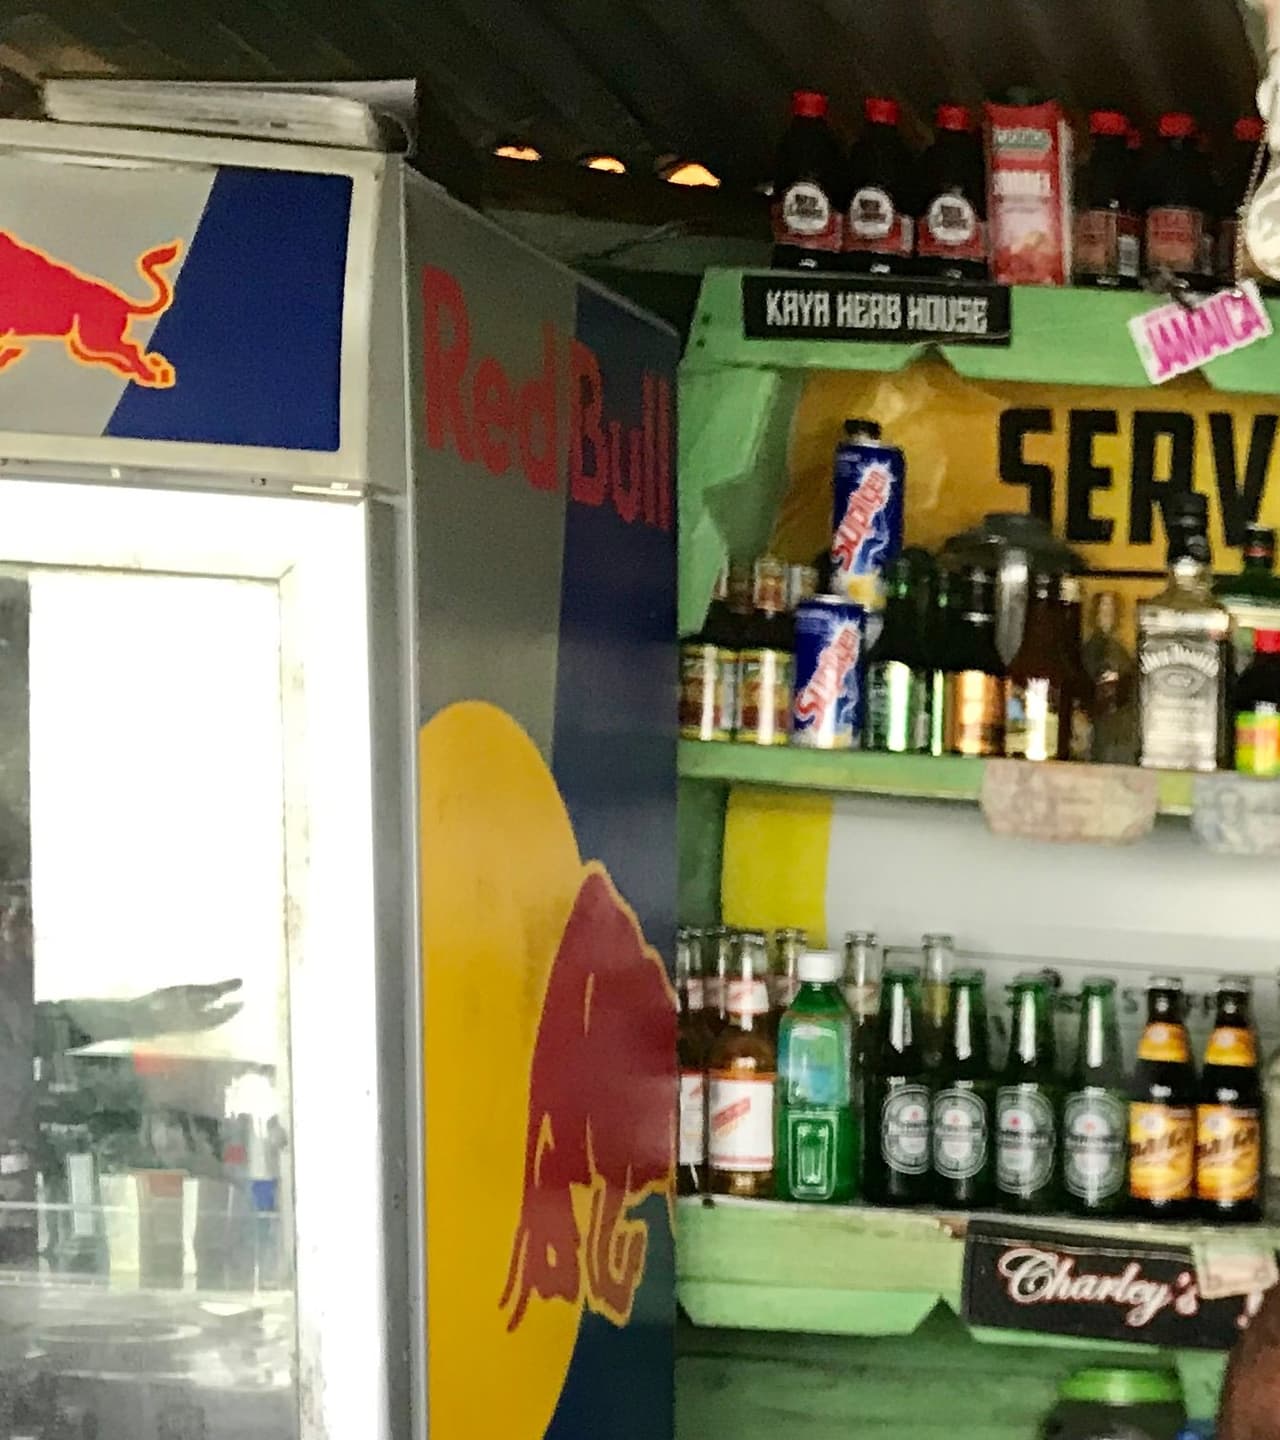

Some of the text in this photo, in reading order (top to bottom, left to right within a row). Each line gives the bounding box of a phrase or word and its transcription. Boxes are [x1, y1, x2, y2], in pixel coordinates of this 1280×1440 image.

[766, 289, 830, 328] KAYA
[906, 295, 989, 335] HOUSE
[1148, 296, 1265, 377] JAMAICA
[421, 264, 673, 531] Red Bull
[998, 1248, 1199, 1327] Charley's
